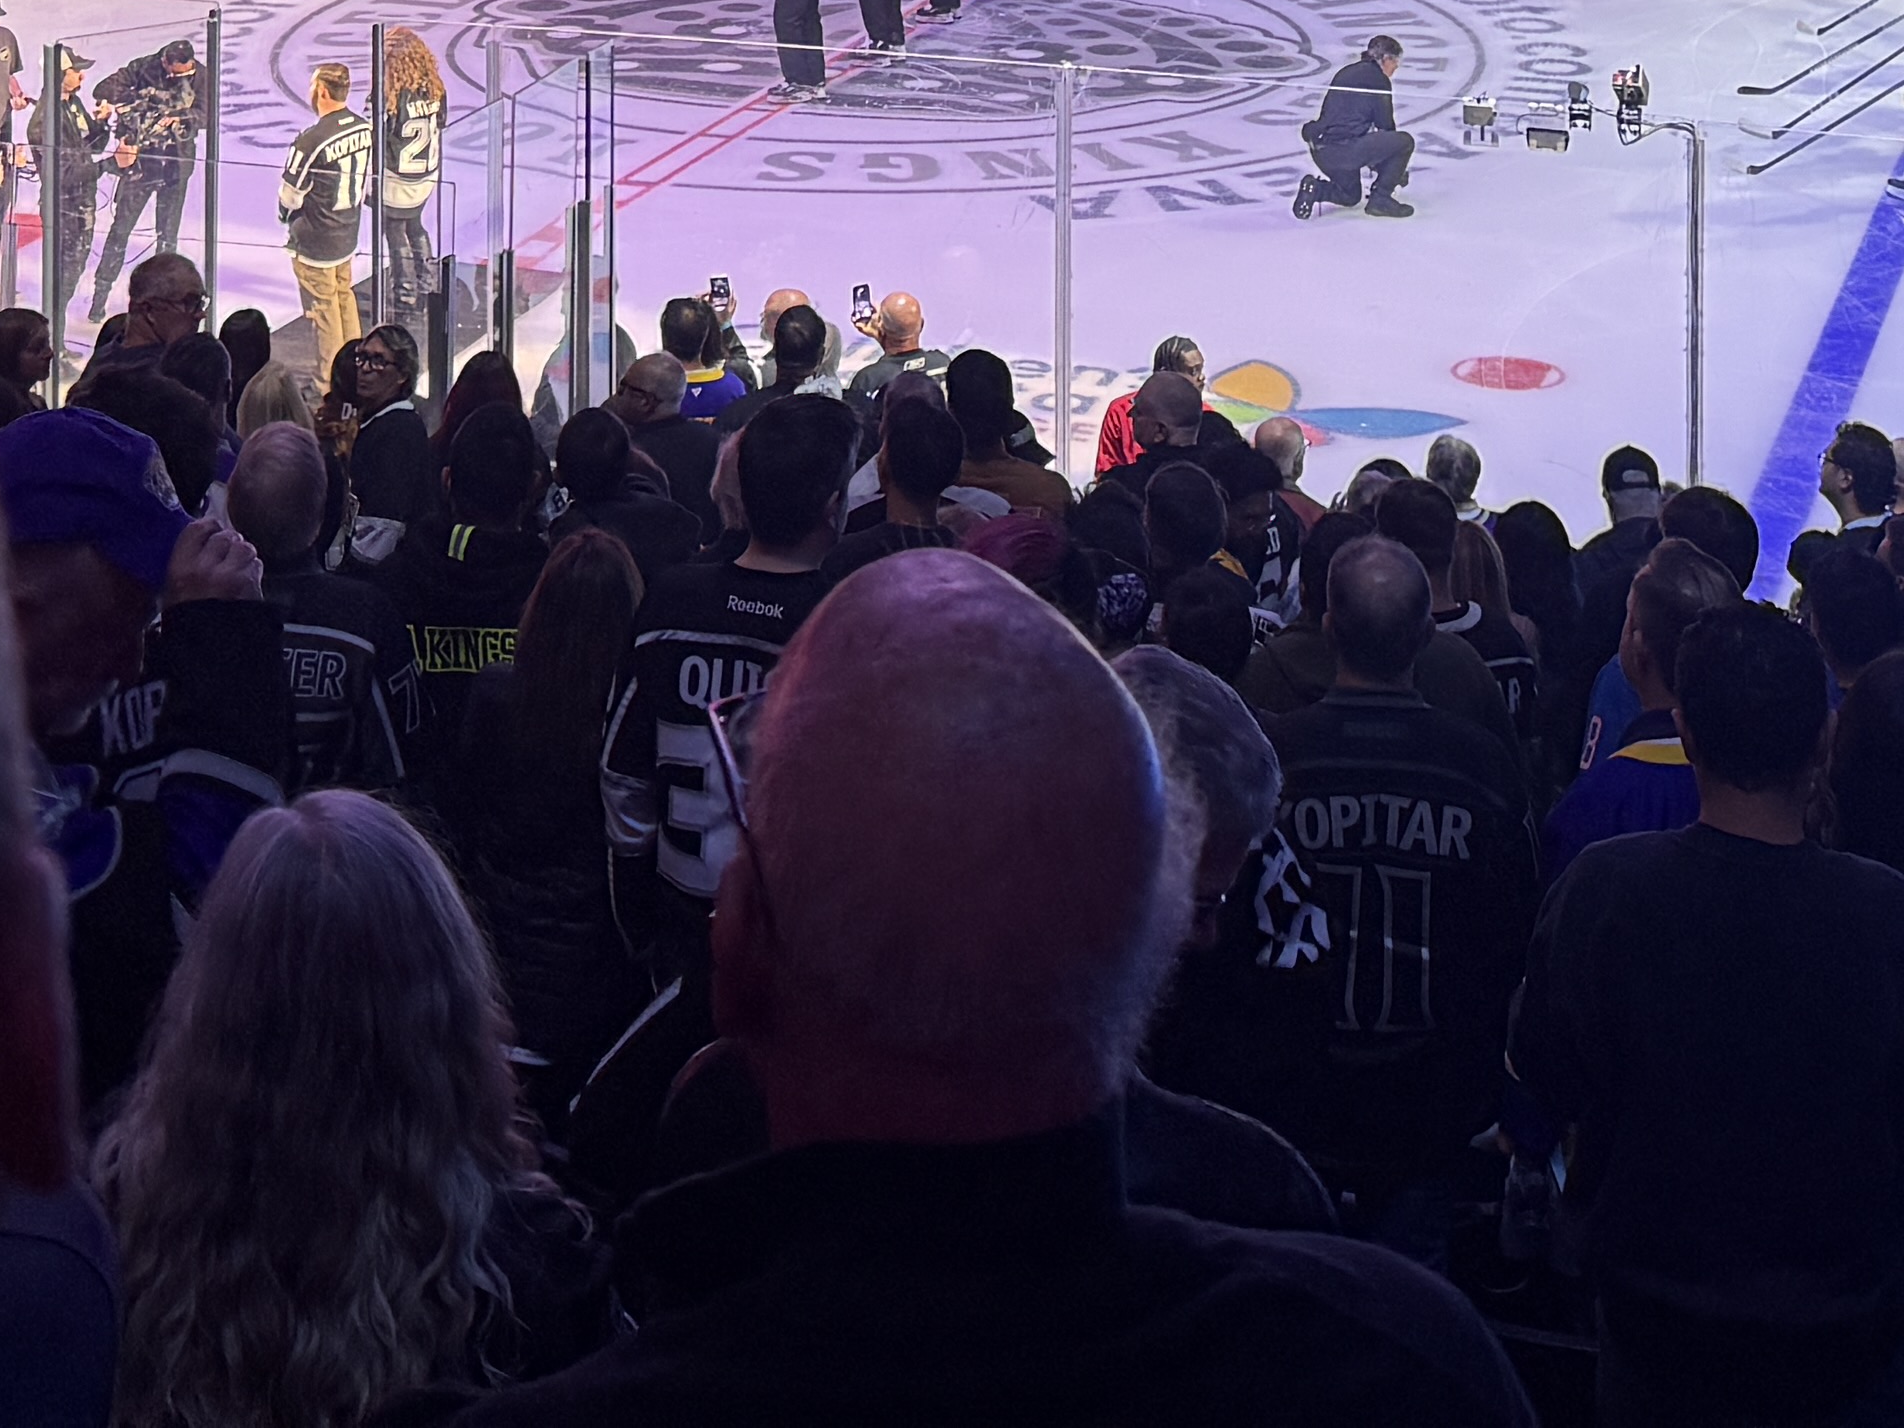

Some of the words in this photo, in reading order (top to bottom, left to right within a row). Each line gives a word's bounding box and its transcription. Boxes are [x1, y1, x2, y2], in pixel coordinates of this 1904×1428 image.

[331, 150, 371, 211] 11
[726, 593, 785, 619] Reebok
[424, 625, 521, 673] KINGS
[1286, 793, 1474, 861] OPITAR
